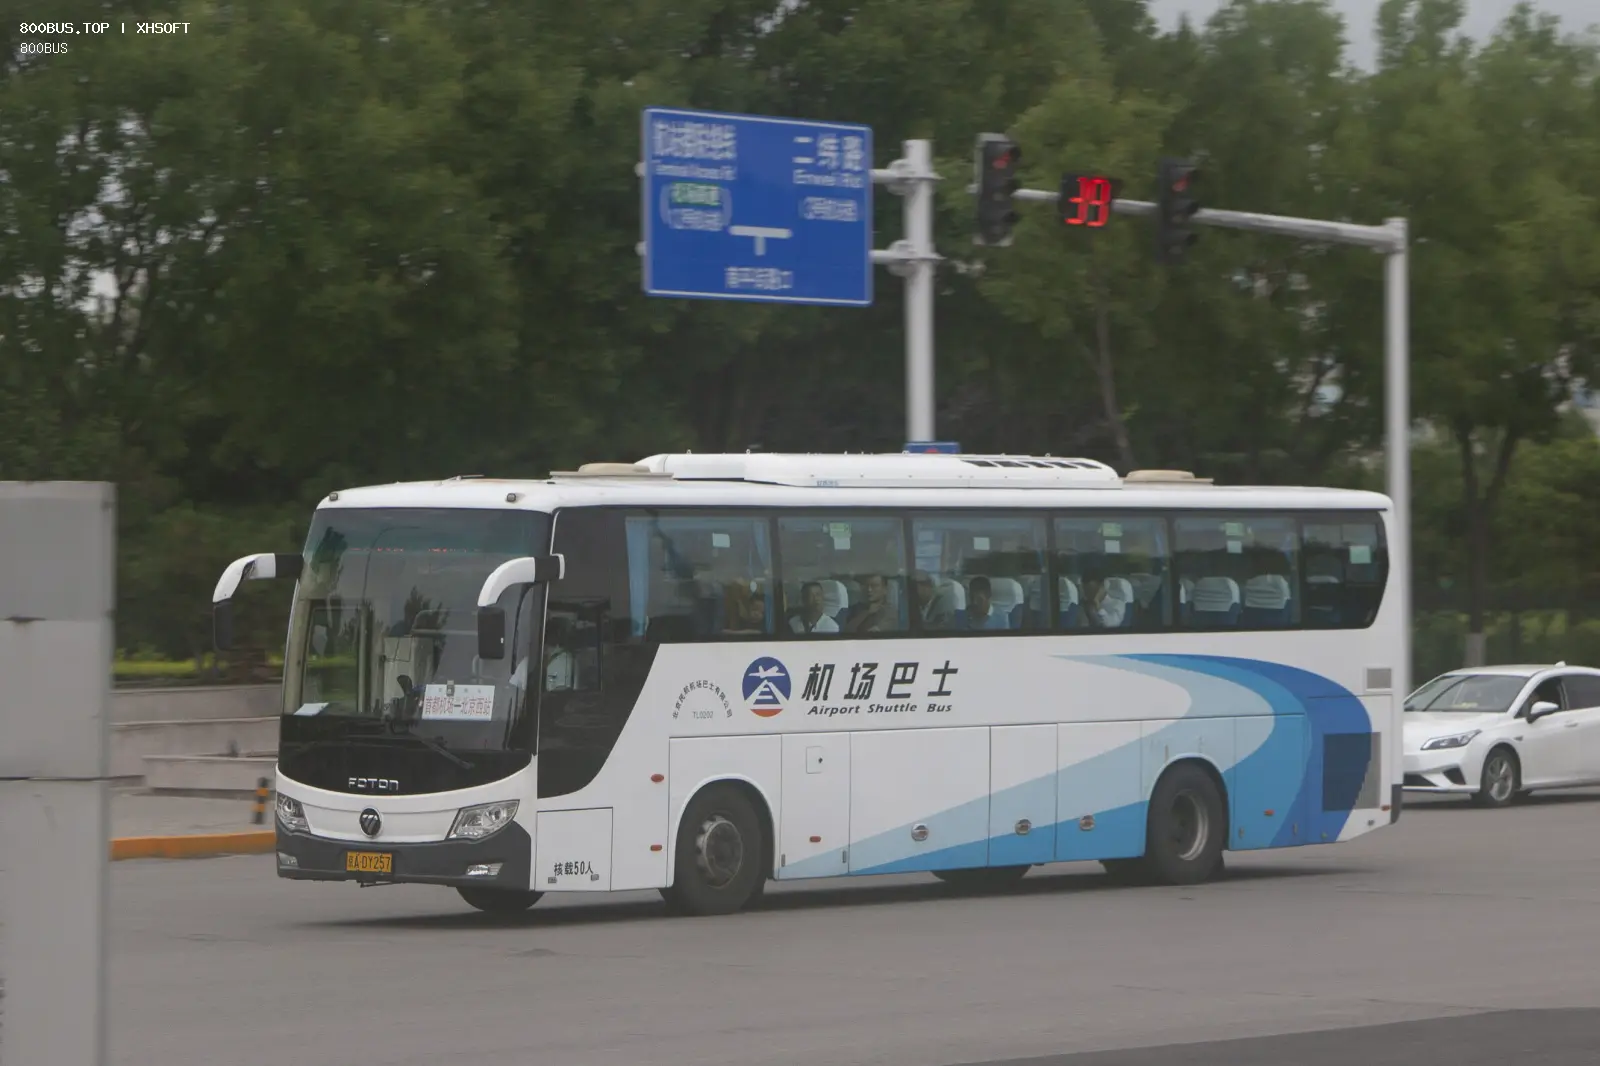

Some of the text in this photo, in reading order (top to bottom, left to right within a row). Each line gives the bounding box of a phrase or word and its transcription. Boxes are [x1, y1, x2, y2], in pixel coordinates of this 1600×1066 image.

[802, 660, 959, 701] 机场巴士
[807, 702, 953, 718] Airport Shuttle Bus
[348, 777, 399, 791] FOTON
[553, 861, 594, 876] 核载50人
